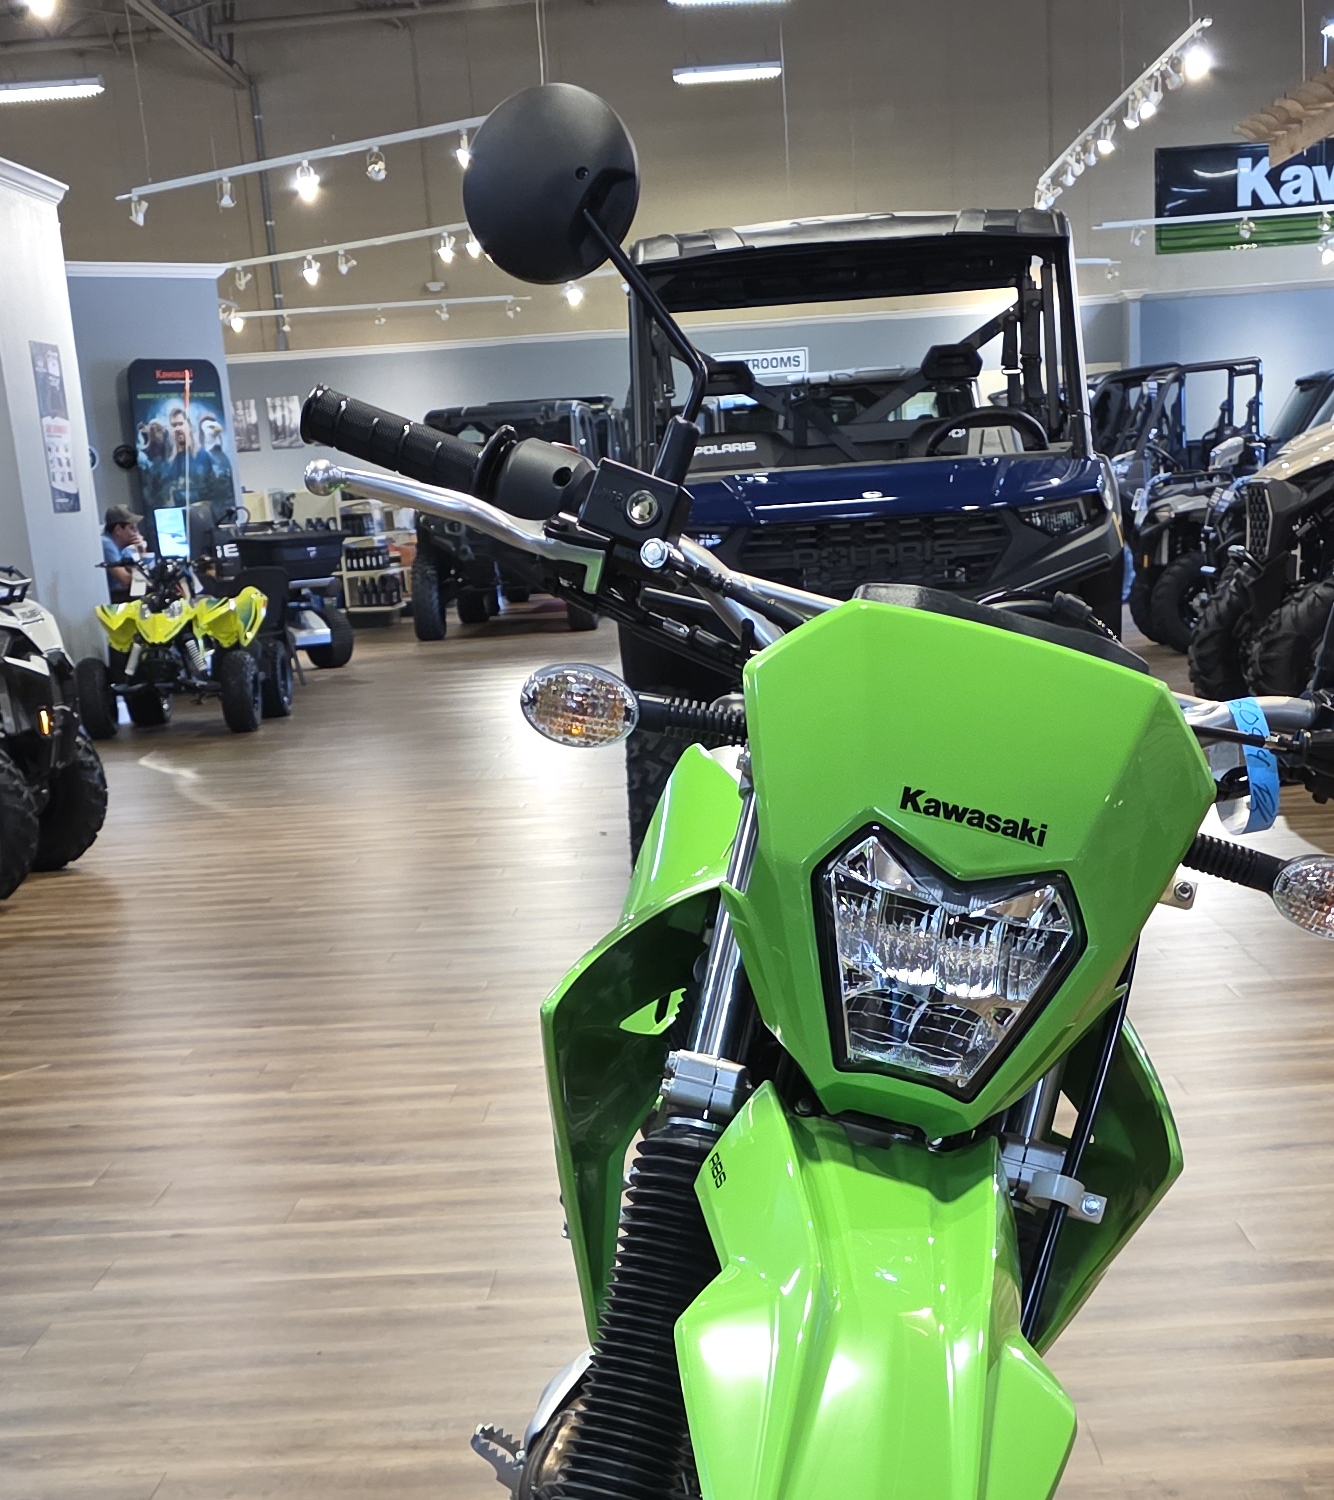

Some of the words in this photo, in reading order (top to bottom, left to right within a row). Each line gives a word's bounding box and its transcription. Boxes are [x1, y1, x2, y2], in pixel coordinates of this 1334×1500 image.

[693, 441, 757, 457] POLARIS
[793, 539, 958, 571] POLARIS
[899, 786, 1048, 847] Kawasaki
[708, 1152, 727, 1189] ABS
